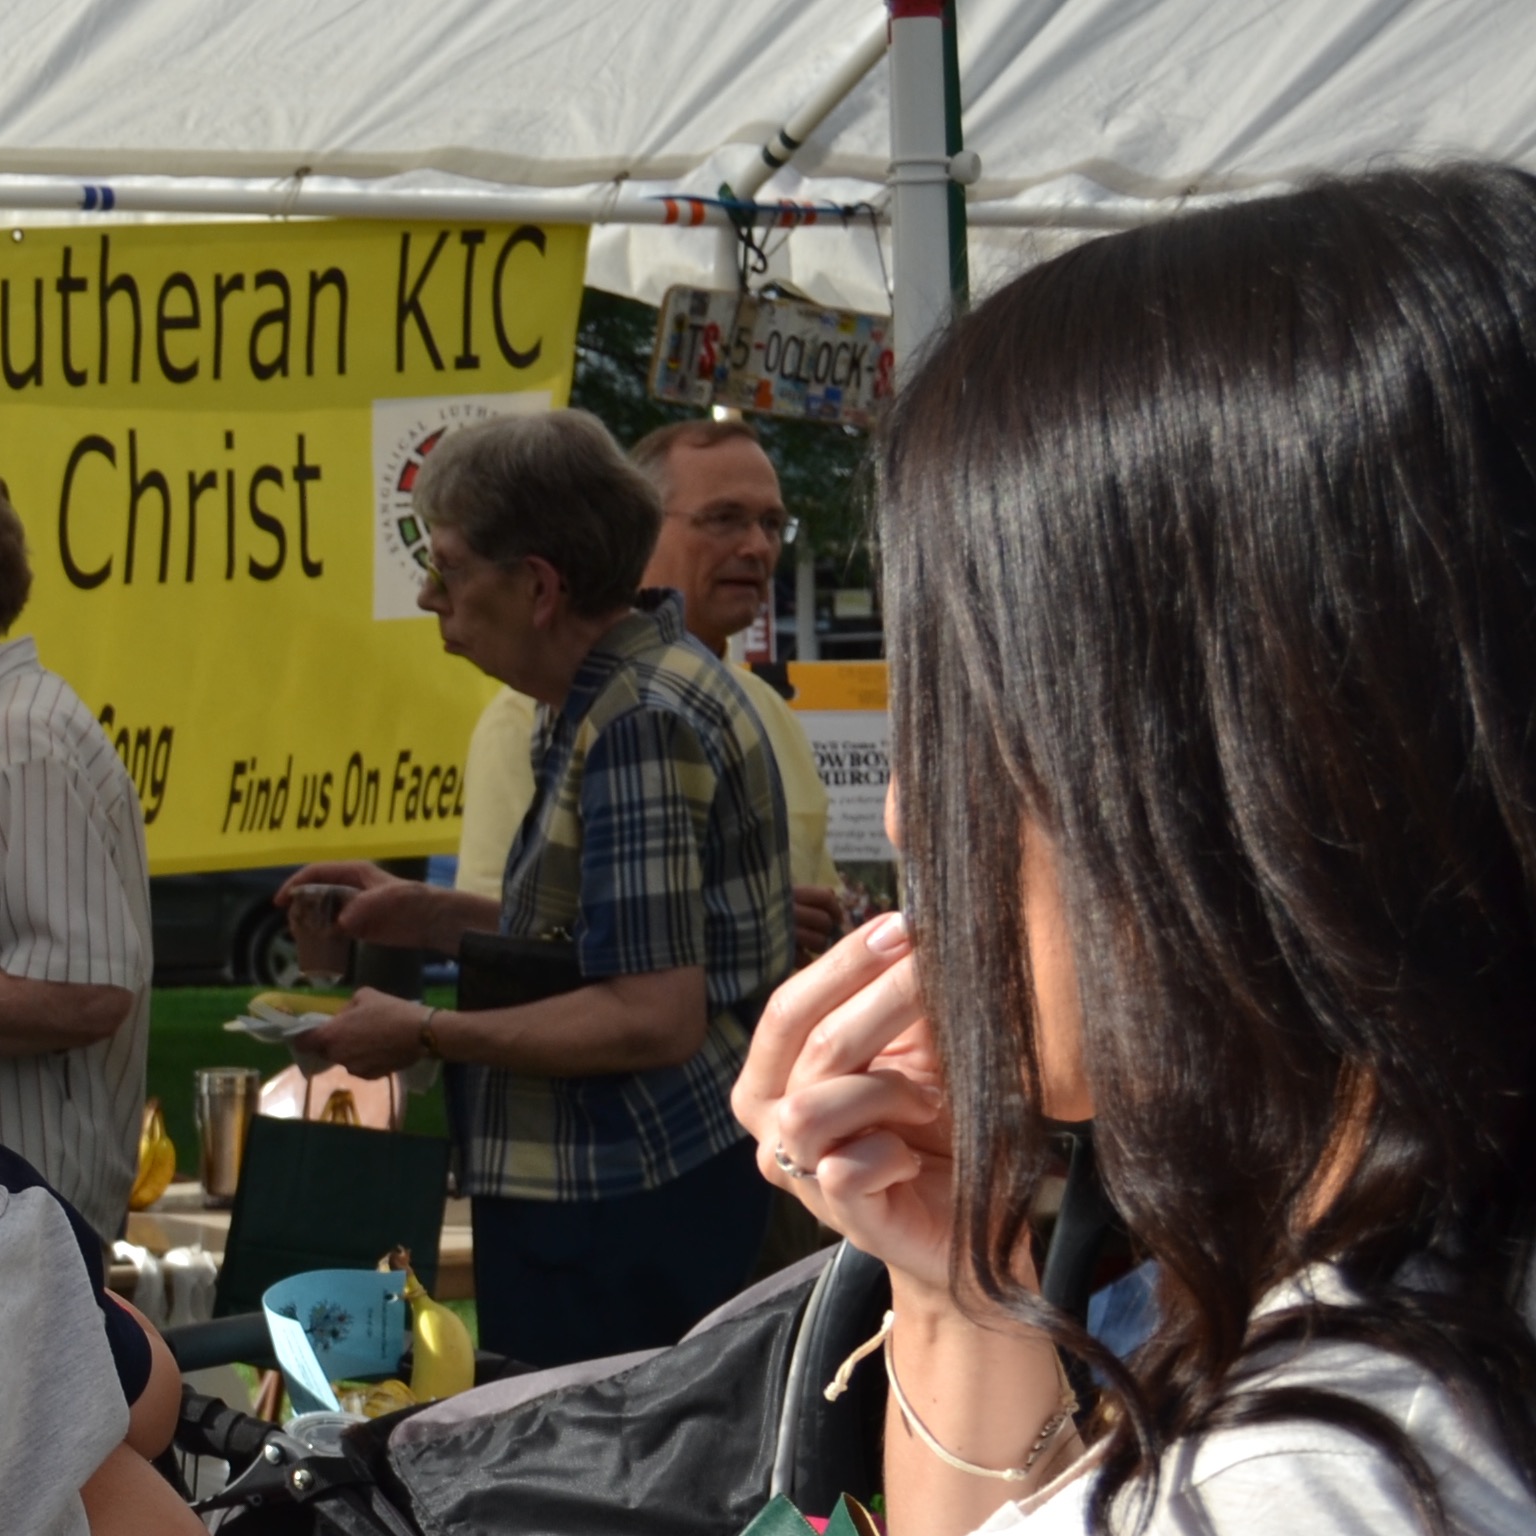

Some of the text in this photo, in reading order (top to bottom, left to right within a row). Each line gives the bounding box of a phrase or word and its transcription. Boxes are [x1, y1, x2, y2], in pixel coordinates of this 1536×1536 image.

[395, 225, 547, 373] KIC
[58, 428, 324, 590] Christ
[223, 754, 293, 833] Find
[296, 771, 333, 830] us
[341, 751, 380, 827] On
[818, 768, 891, 786] HURCH
